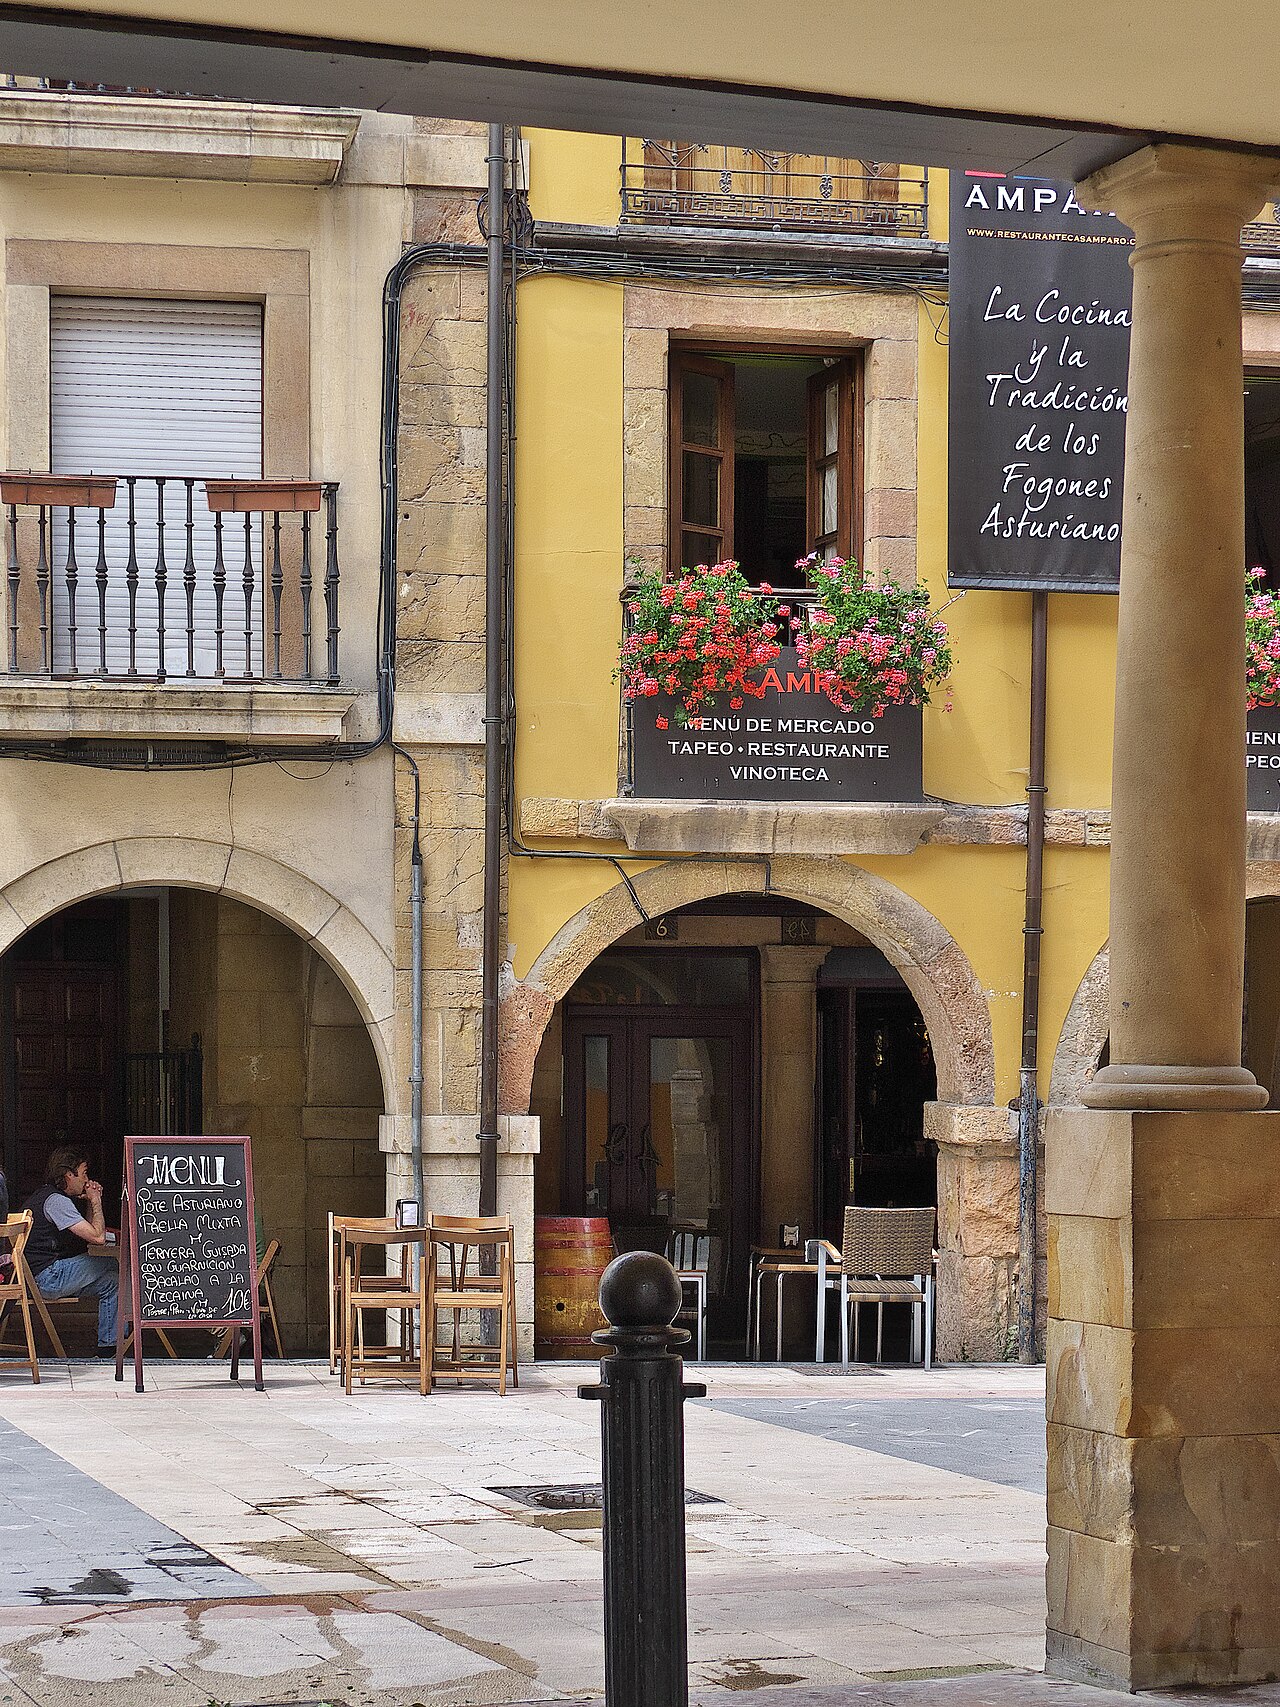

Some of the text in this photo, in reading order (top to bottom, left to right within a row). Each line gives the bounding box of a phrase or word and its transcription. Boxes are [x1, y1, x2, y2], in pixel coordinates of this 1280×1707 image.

[983, 285, 1133, 328] La Cocina
[1013, 335, 1090, 384] y la
[985, 373, 1128, 413] Tradición
[1015, 422, 1100, 455] de los
[1002, 462, 1112, 512] Fogones
[980, 502, 1123, 542] Asturiano
[684, 714, 876, 734] MENÚ DE MERCADO
[667, 740, 891, 759] TAPEO RESTAURANTE
[729, 766, 830, 781] VINOTECA
[655, 917, 668, 937] 6
[138, 1154, 241, 1187] MENU
[136, 1188, 243, 1214] POTE ASTURIANO
[138, 1213, 242, 1233] PAELLA MIXTA
[140, 1238, 196, 1261] TERNERA
[141, 1272, 245, 1289] BACALAO A LA
[144, 1288, 204, 1304] VIZCAINA
[221, 1288, 251, 1316] 10€
